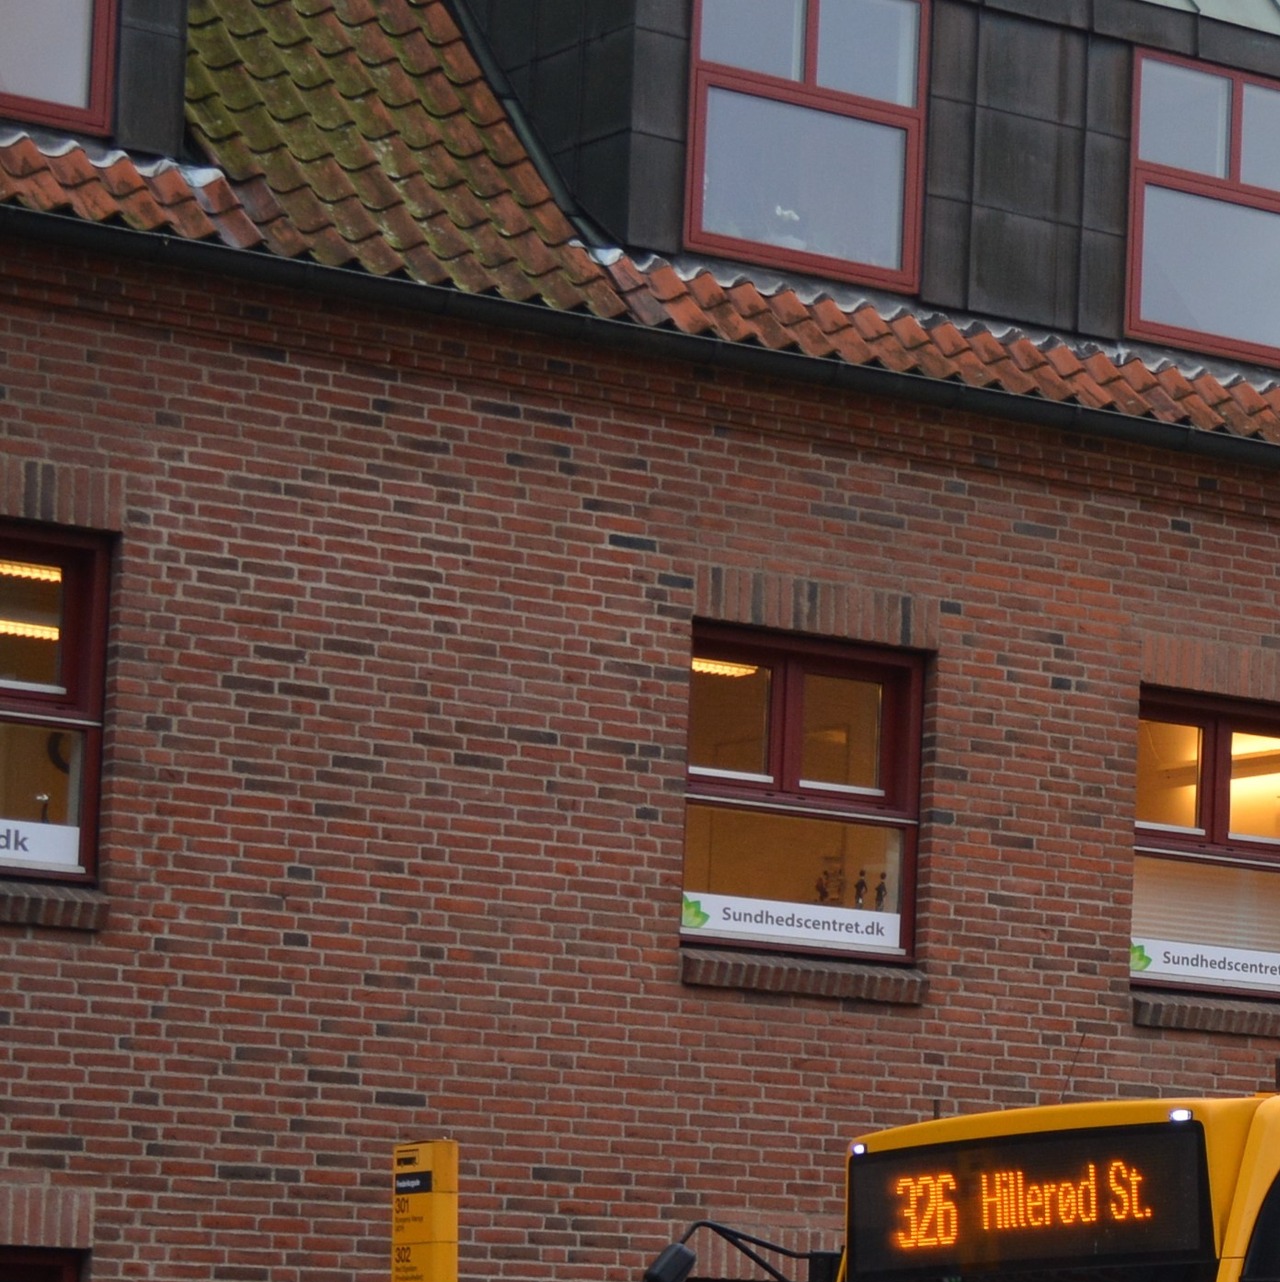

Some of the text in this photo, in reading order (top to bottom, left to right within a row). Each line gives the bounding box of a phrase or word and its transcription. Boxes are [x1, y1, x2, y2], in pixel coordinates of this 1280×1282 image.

[722, 907, 885, 936] Sundhedscentret.dk
[896, 1160, 1152, 1248] 326 Hillerød St.
[396, 1246, 411, 1264] 302
